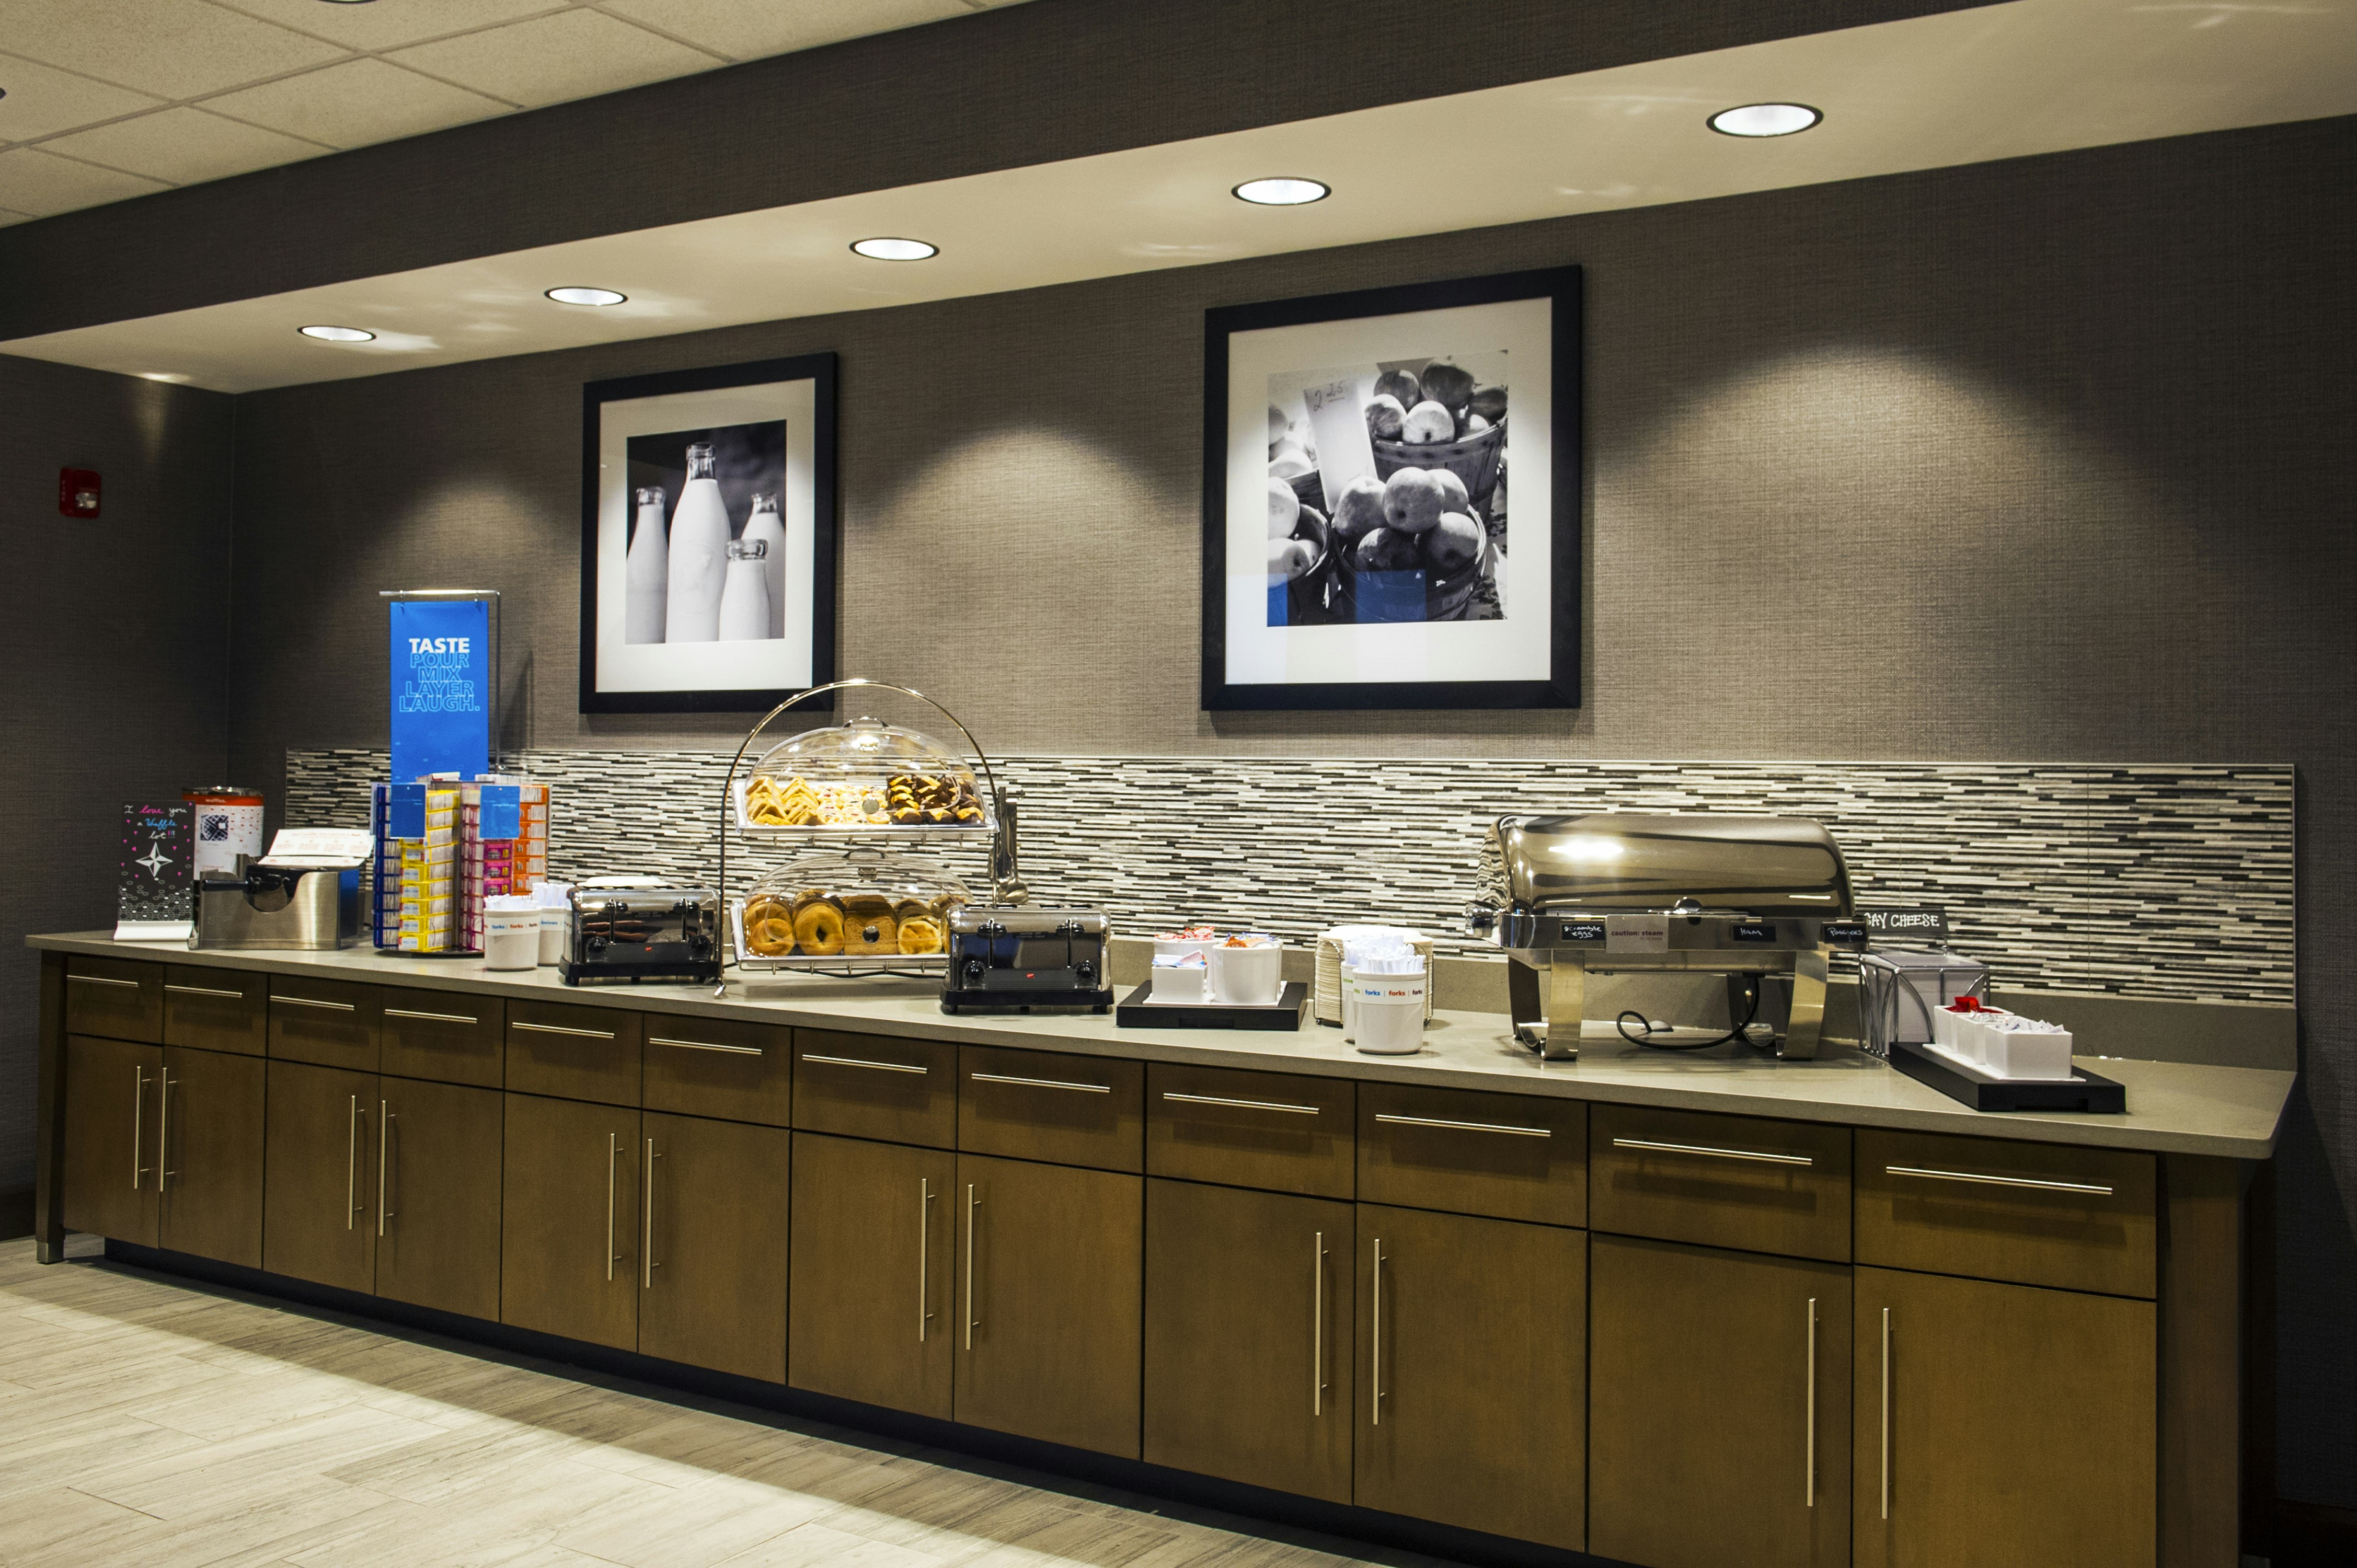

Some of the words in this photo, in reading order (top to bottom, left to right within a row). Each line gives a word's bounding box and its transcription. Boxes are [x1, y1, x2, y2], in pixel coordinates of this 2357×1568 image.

[408, 638, 470, 653] TASTE
[410, 652, 469, 668] POUR
[418, 666, 462, 683] MIX
[406, 680, 475, 697] LAYER
[399, 695, 480, 712] LAUGH.
[124, 805, 133, 814] I
[139, 805, 164, 814] love
[169, 808, 187, 817] you
[145, 818, 177, 830] Waffle
[1891, 914, 1940, 927] CHEESE
